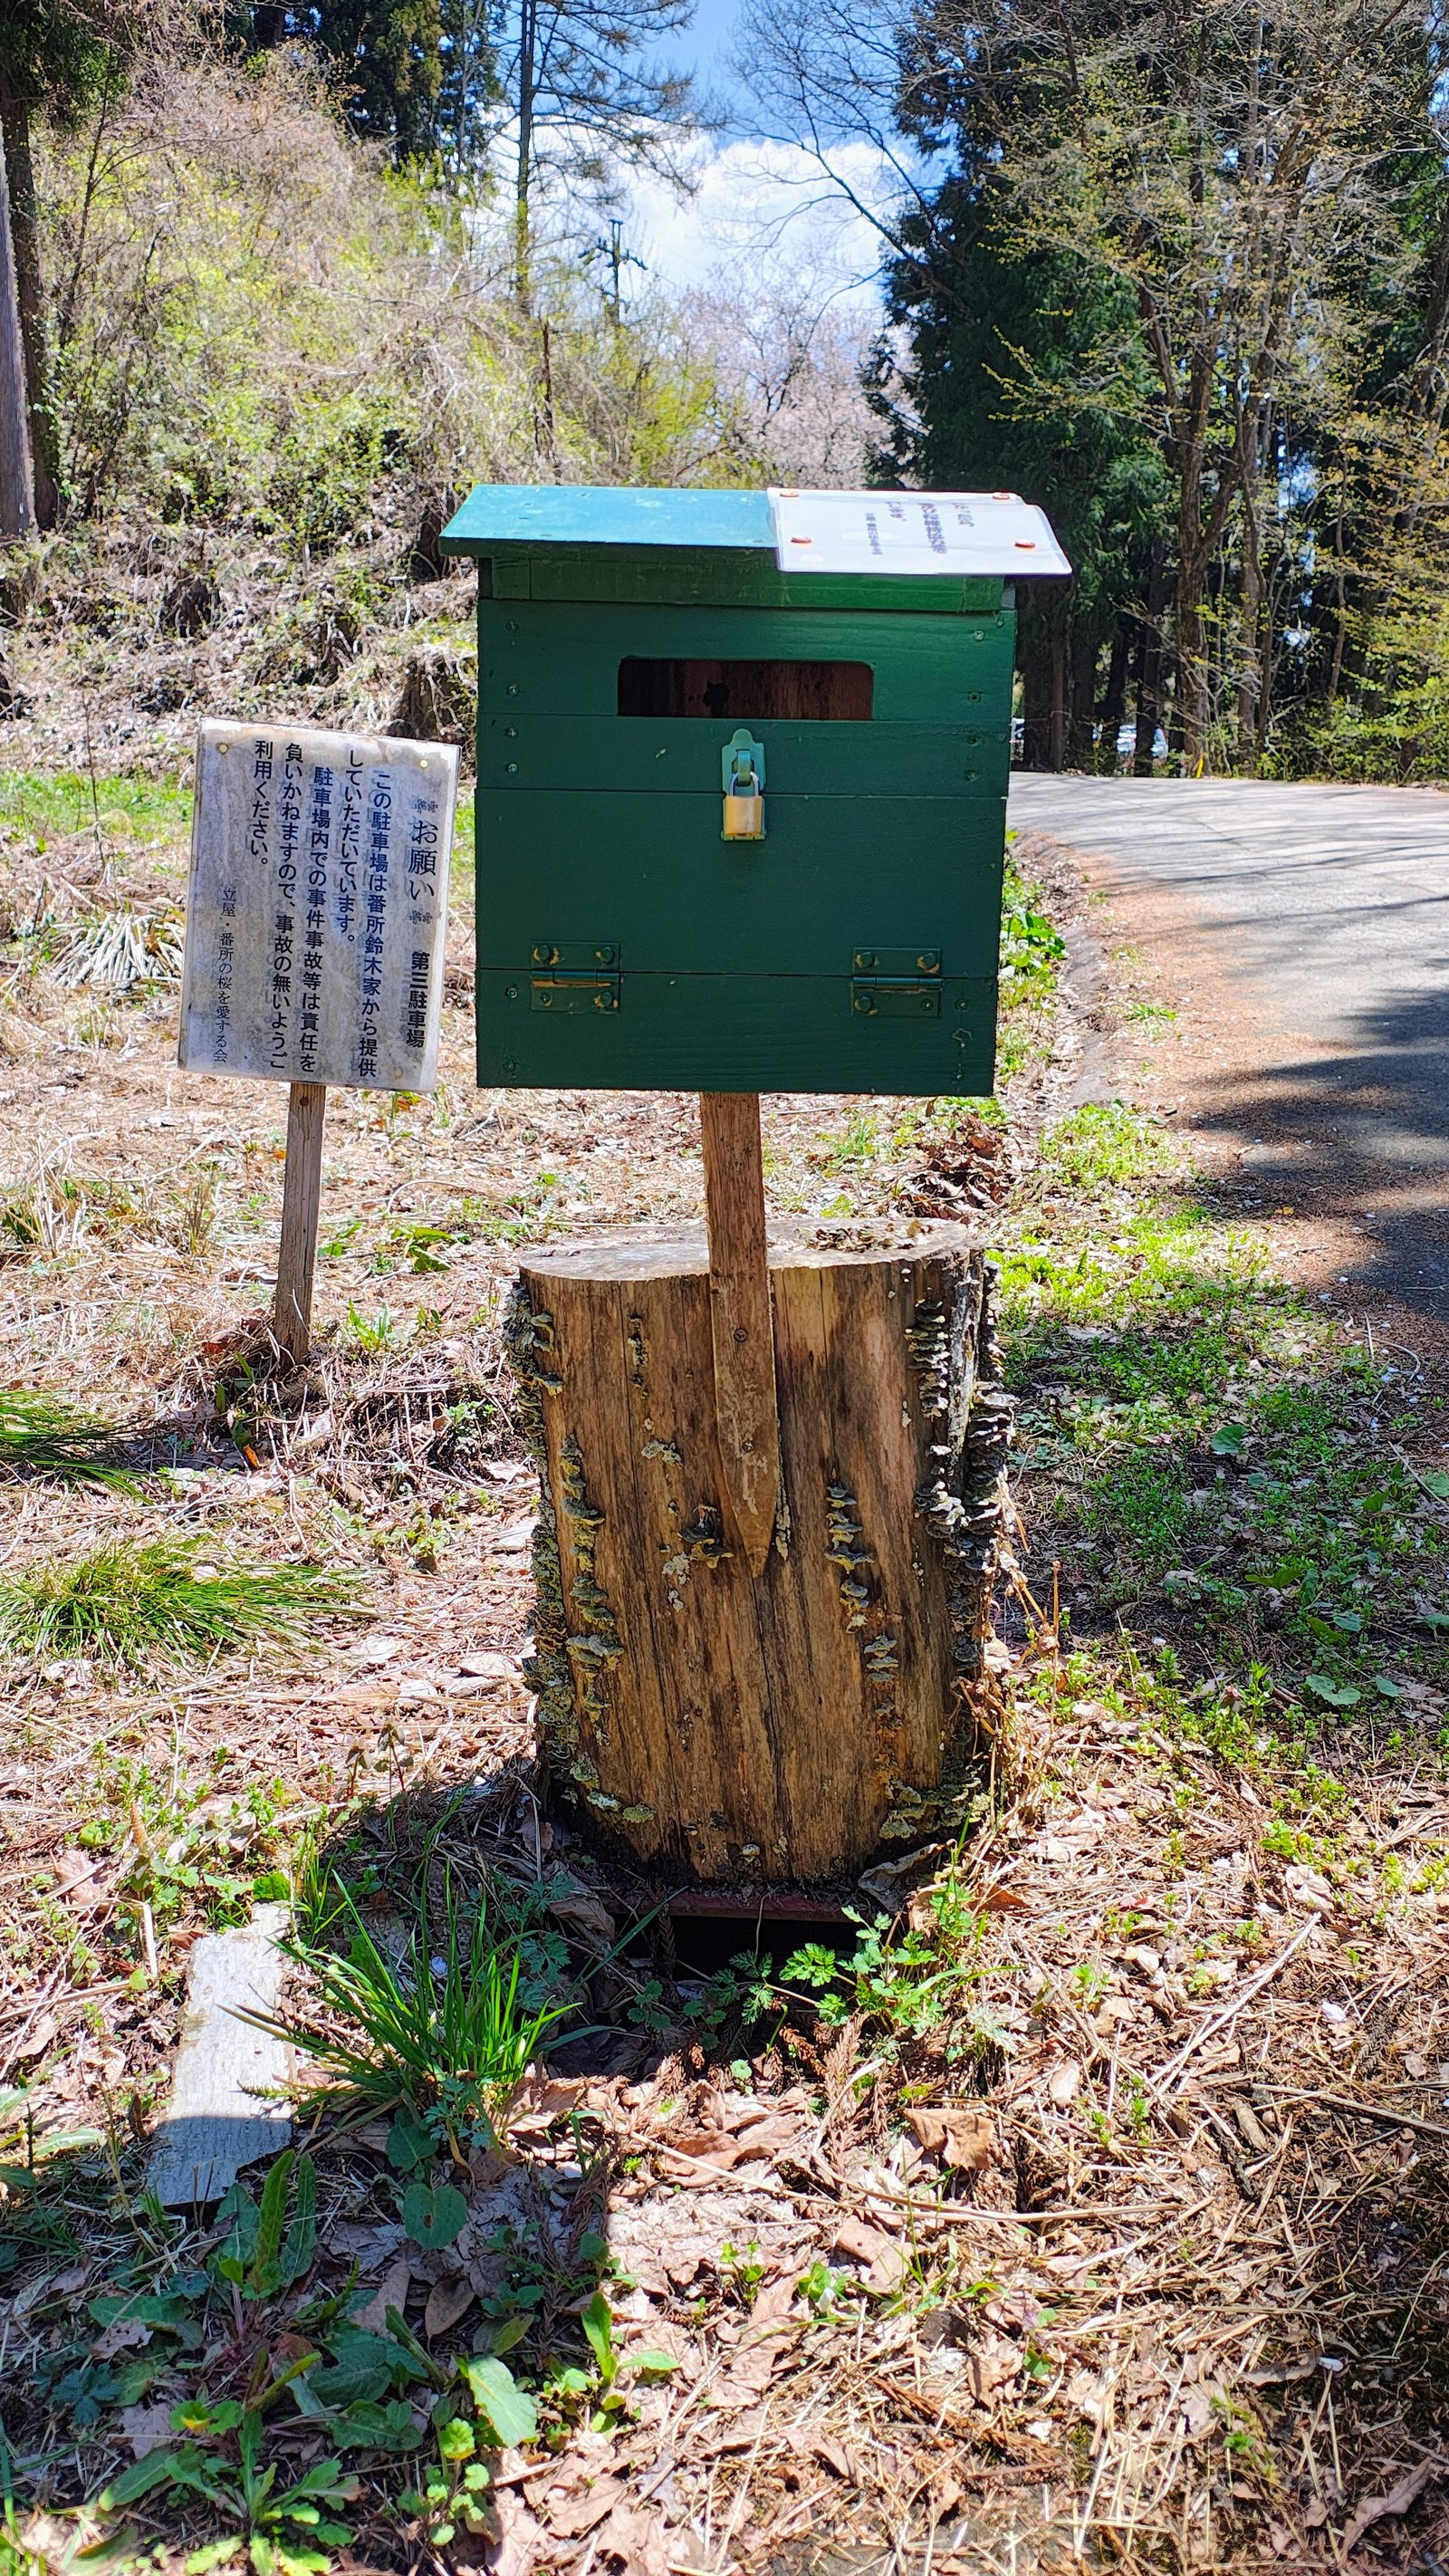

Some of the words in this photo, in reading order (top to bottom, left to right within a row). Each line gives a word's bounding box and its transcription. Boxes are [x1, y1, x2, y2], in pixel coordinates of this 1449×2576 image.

[250, 740, 273, 865] 利用ください。
[337, 750, 363, 942] していただいています。
[408, 820, 438, 900] お願い
[271, 743, 303, 1069] 負いかねますので、事故の無いようご
[299, 766, 333, 1072] 駐車場内での事件事故等は責任を
[358, 773, 392, 1077] この駐車場は番所鈴木家から提供
[406, 951, 430, 1048] 第三駐車場
